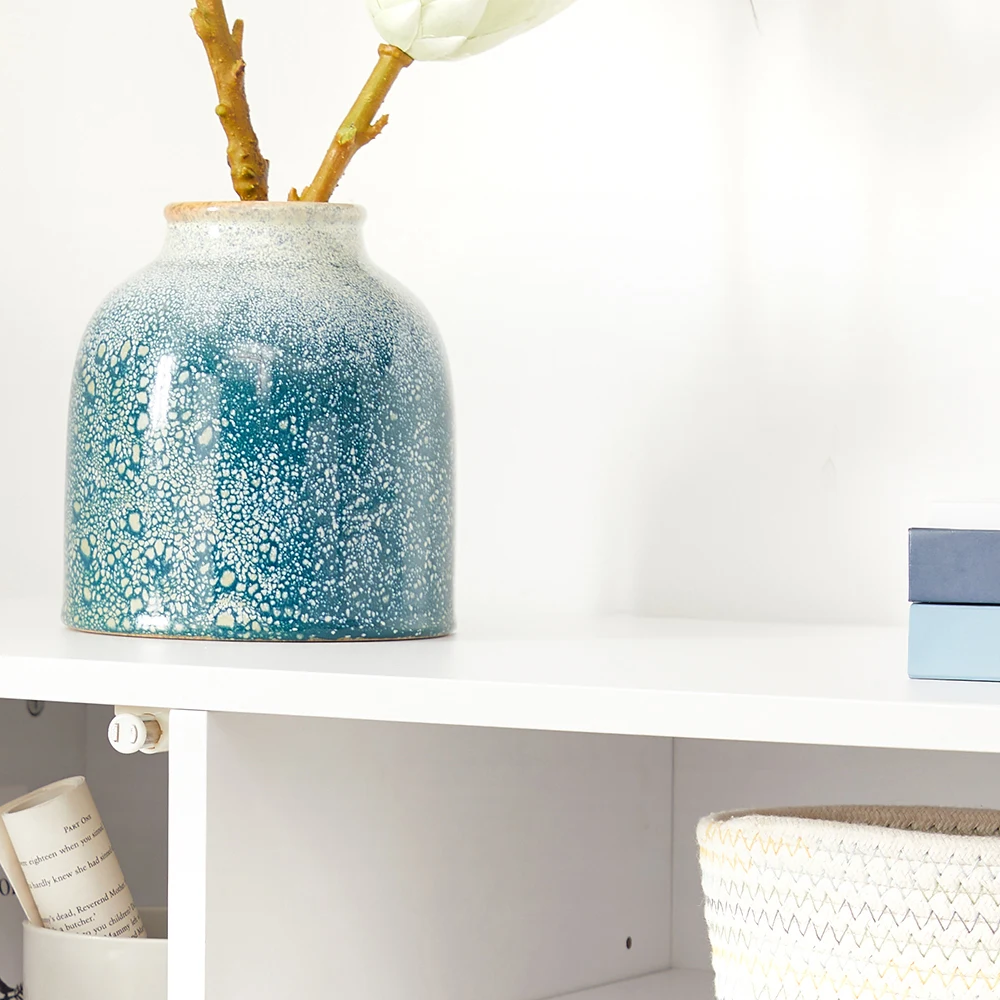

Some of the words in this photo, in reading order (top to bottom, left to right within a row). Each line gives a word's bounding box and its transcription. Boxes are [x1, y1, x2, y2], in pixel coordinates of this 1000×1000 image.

[28, 851, 58, 867] eighteen
[59, 842, 80, 855] when
[80, 835, 92, 847] you
[51, 871, 73, 884] knew
[74, 865, 87, 876] she
[87, 855, 100, 869] had
[56, 909, 77, 922] dead,
[76, 892, 109, 914] Reverend
[93, 923, 107, 936] you
